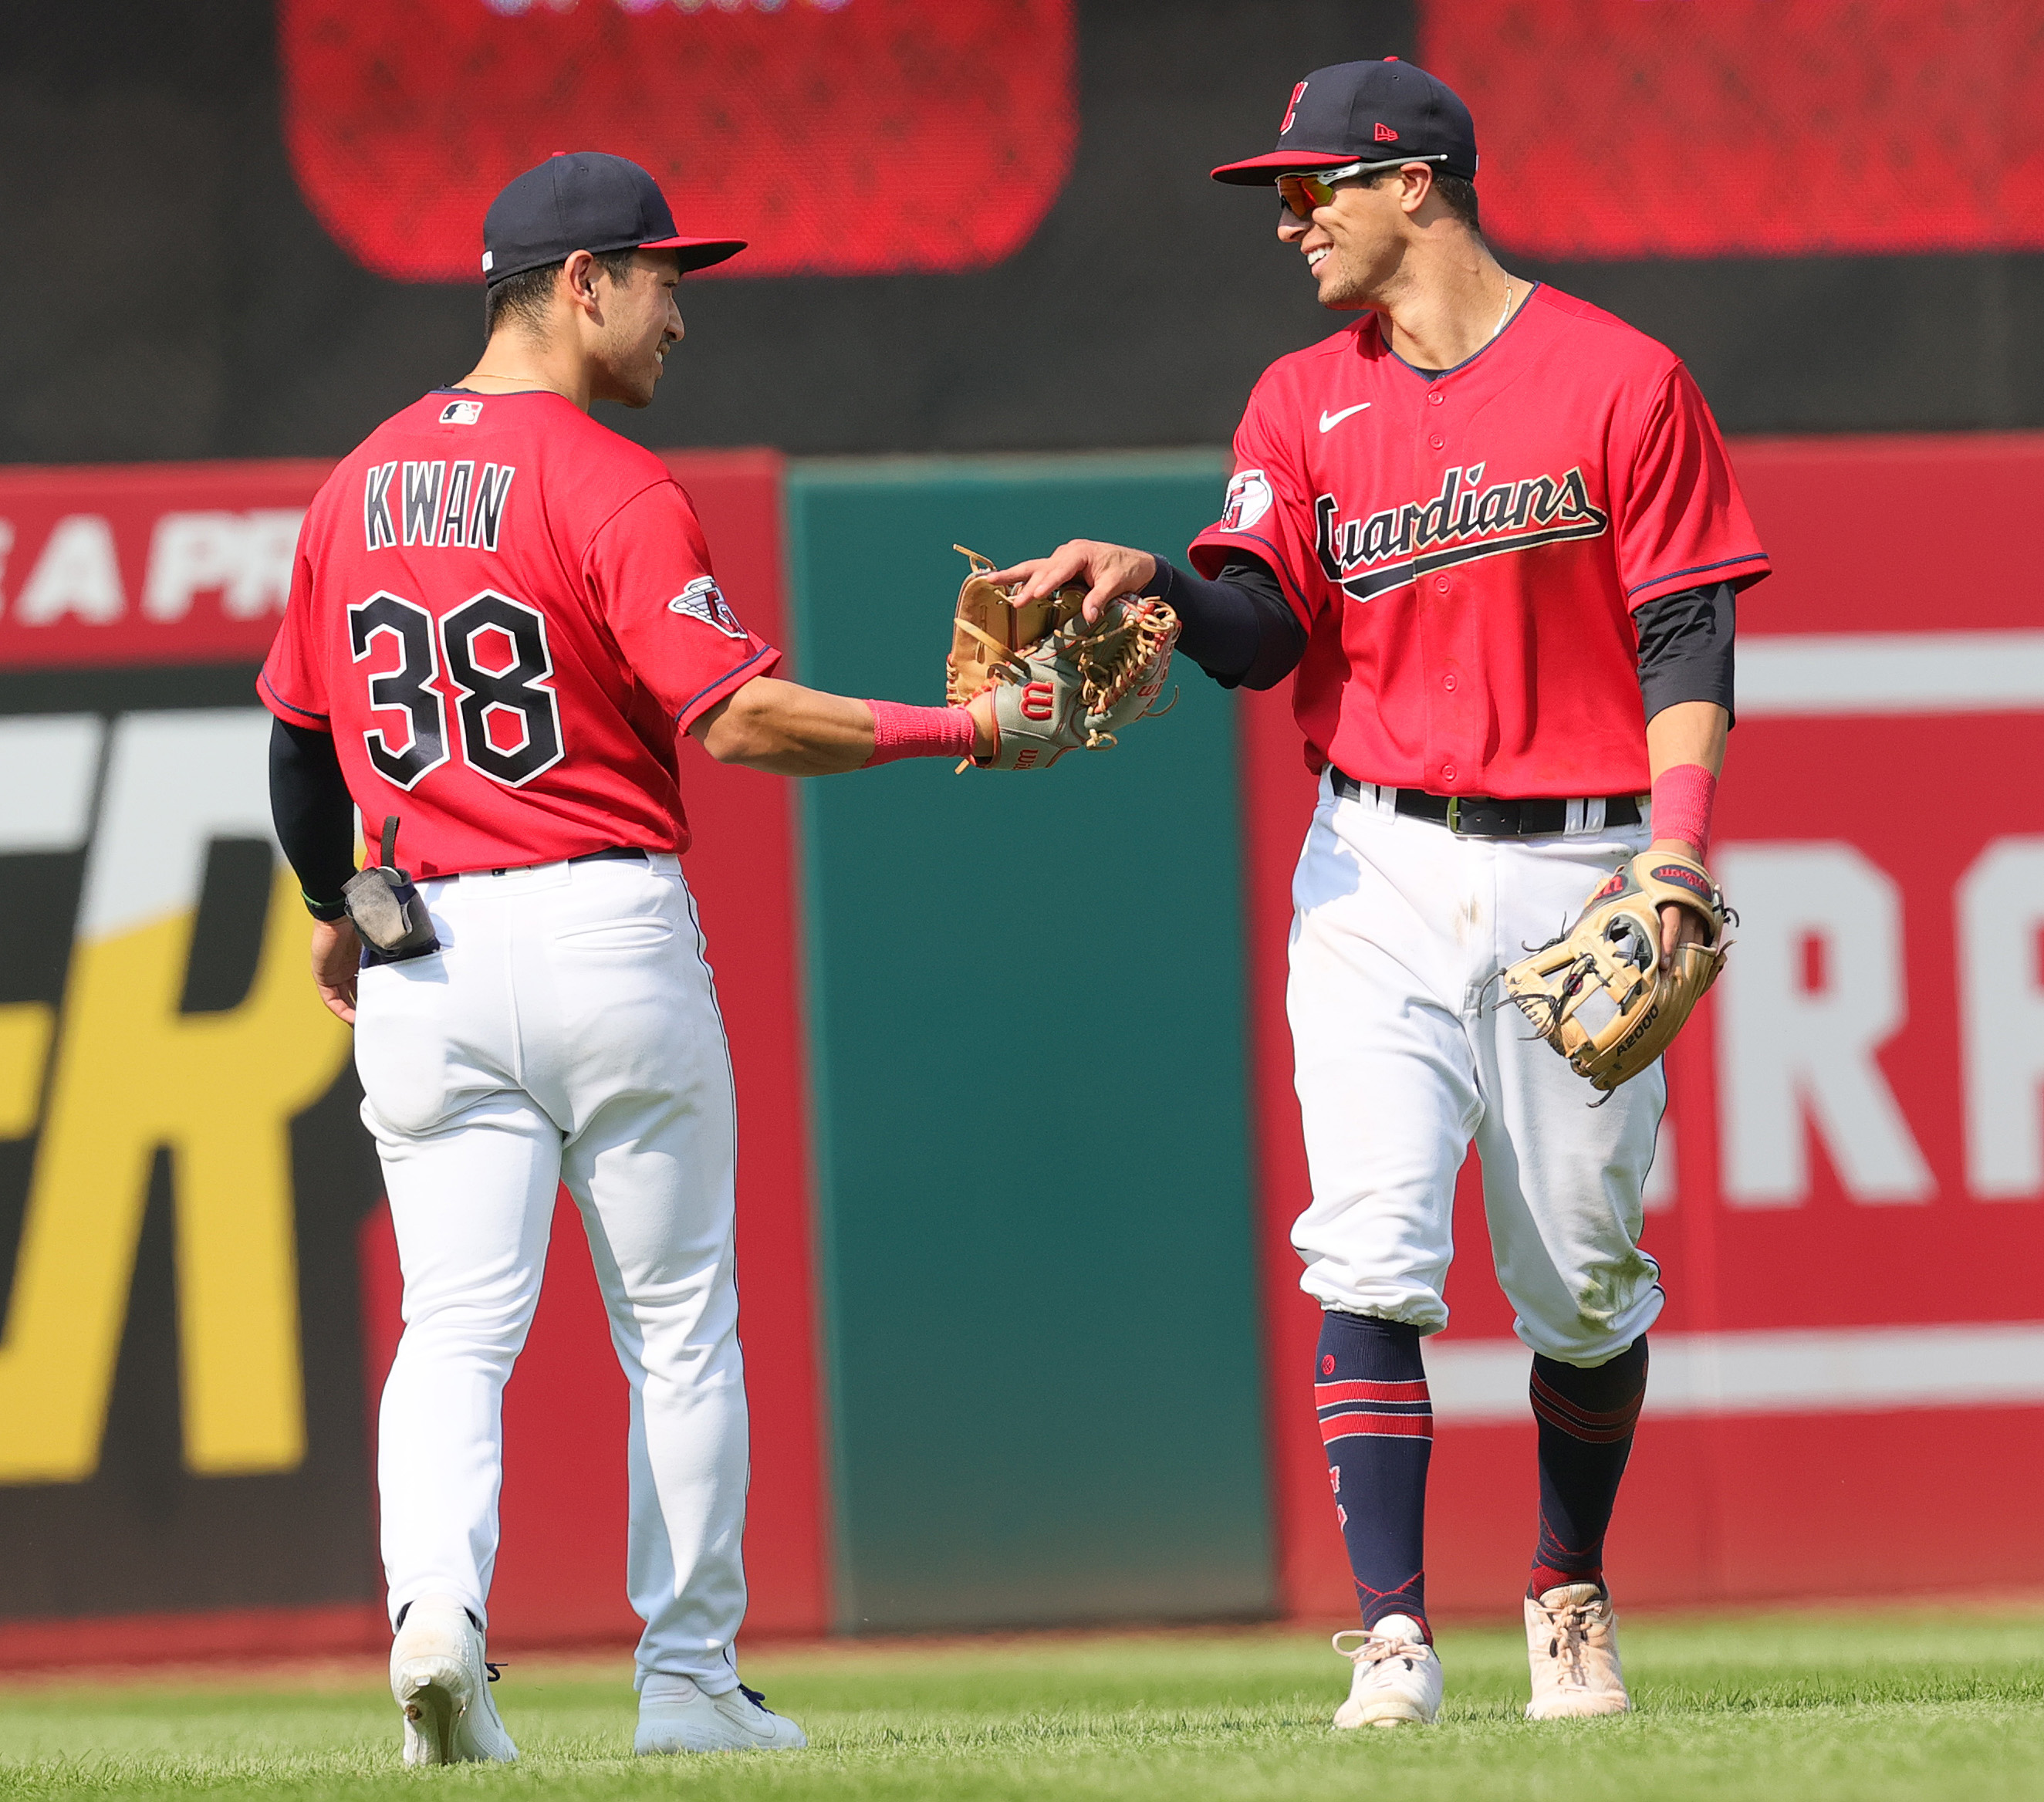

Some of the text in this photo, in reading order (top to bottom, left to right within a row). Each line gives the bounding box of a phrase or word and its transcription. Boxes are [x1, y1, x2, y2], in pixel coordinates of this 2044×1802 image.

[364, 461, 515, 553] KWAN
[1315, 461, 1607, 585] Guardians
[15, 512, 127, 627] A
[347, 589, 566, 792] 38
[1616, 1004, 1659, 1057] A2000
